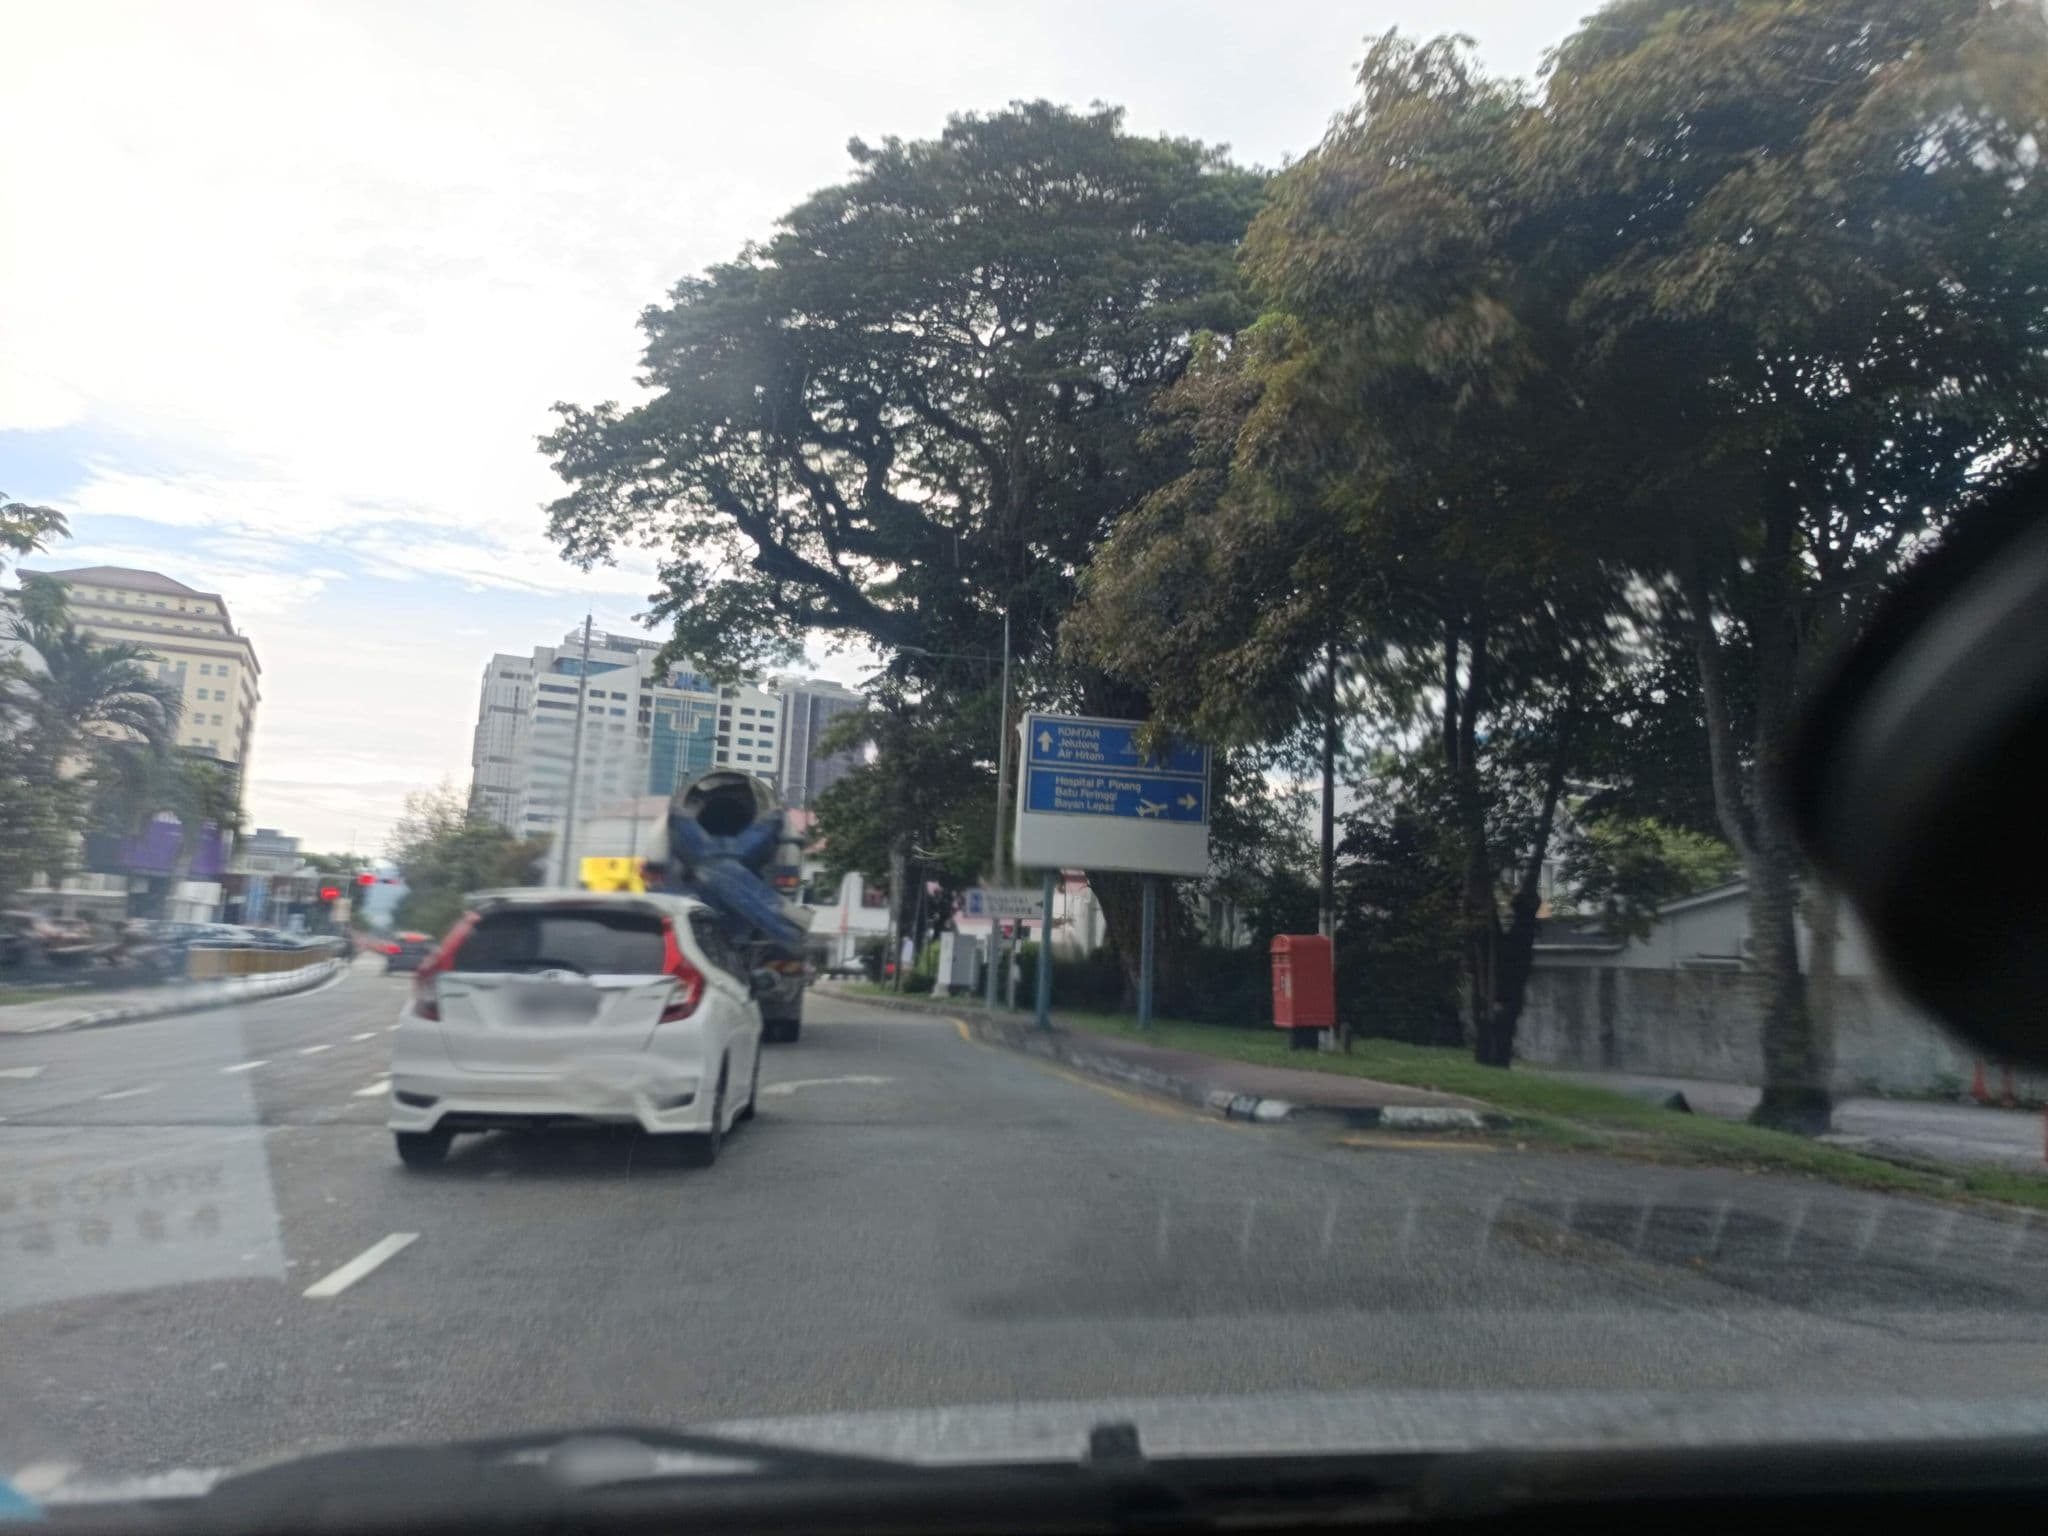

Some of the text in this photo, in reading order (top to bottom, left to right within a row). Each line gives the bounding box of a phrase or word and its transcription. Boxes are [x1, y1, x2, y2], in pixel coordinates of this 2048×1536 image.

[1058, 728, 1100, 739] KOMTAR
[1058, 749, 1104, 761] Air Hitam
[1056, 777, 1094, 788] Hospital
[1109, 779, 1142, 794] Pinang
[1055, 787, 1079, 797] Batu
[1054, 798, 1085, 810] Bayan
